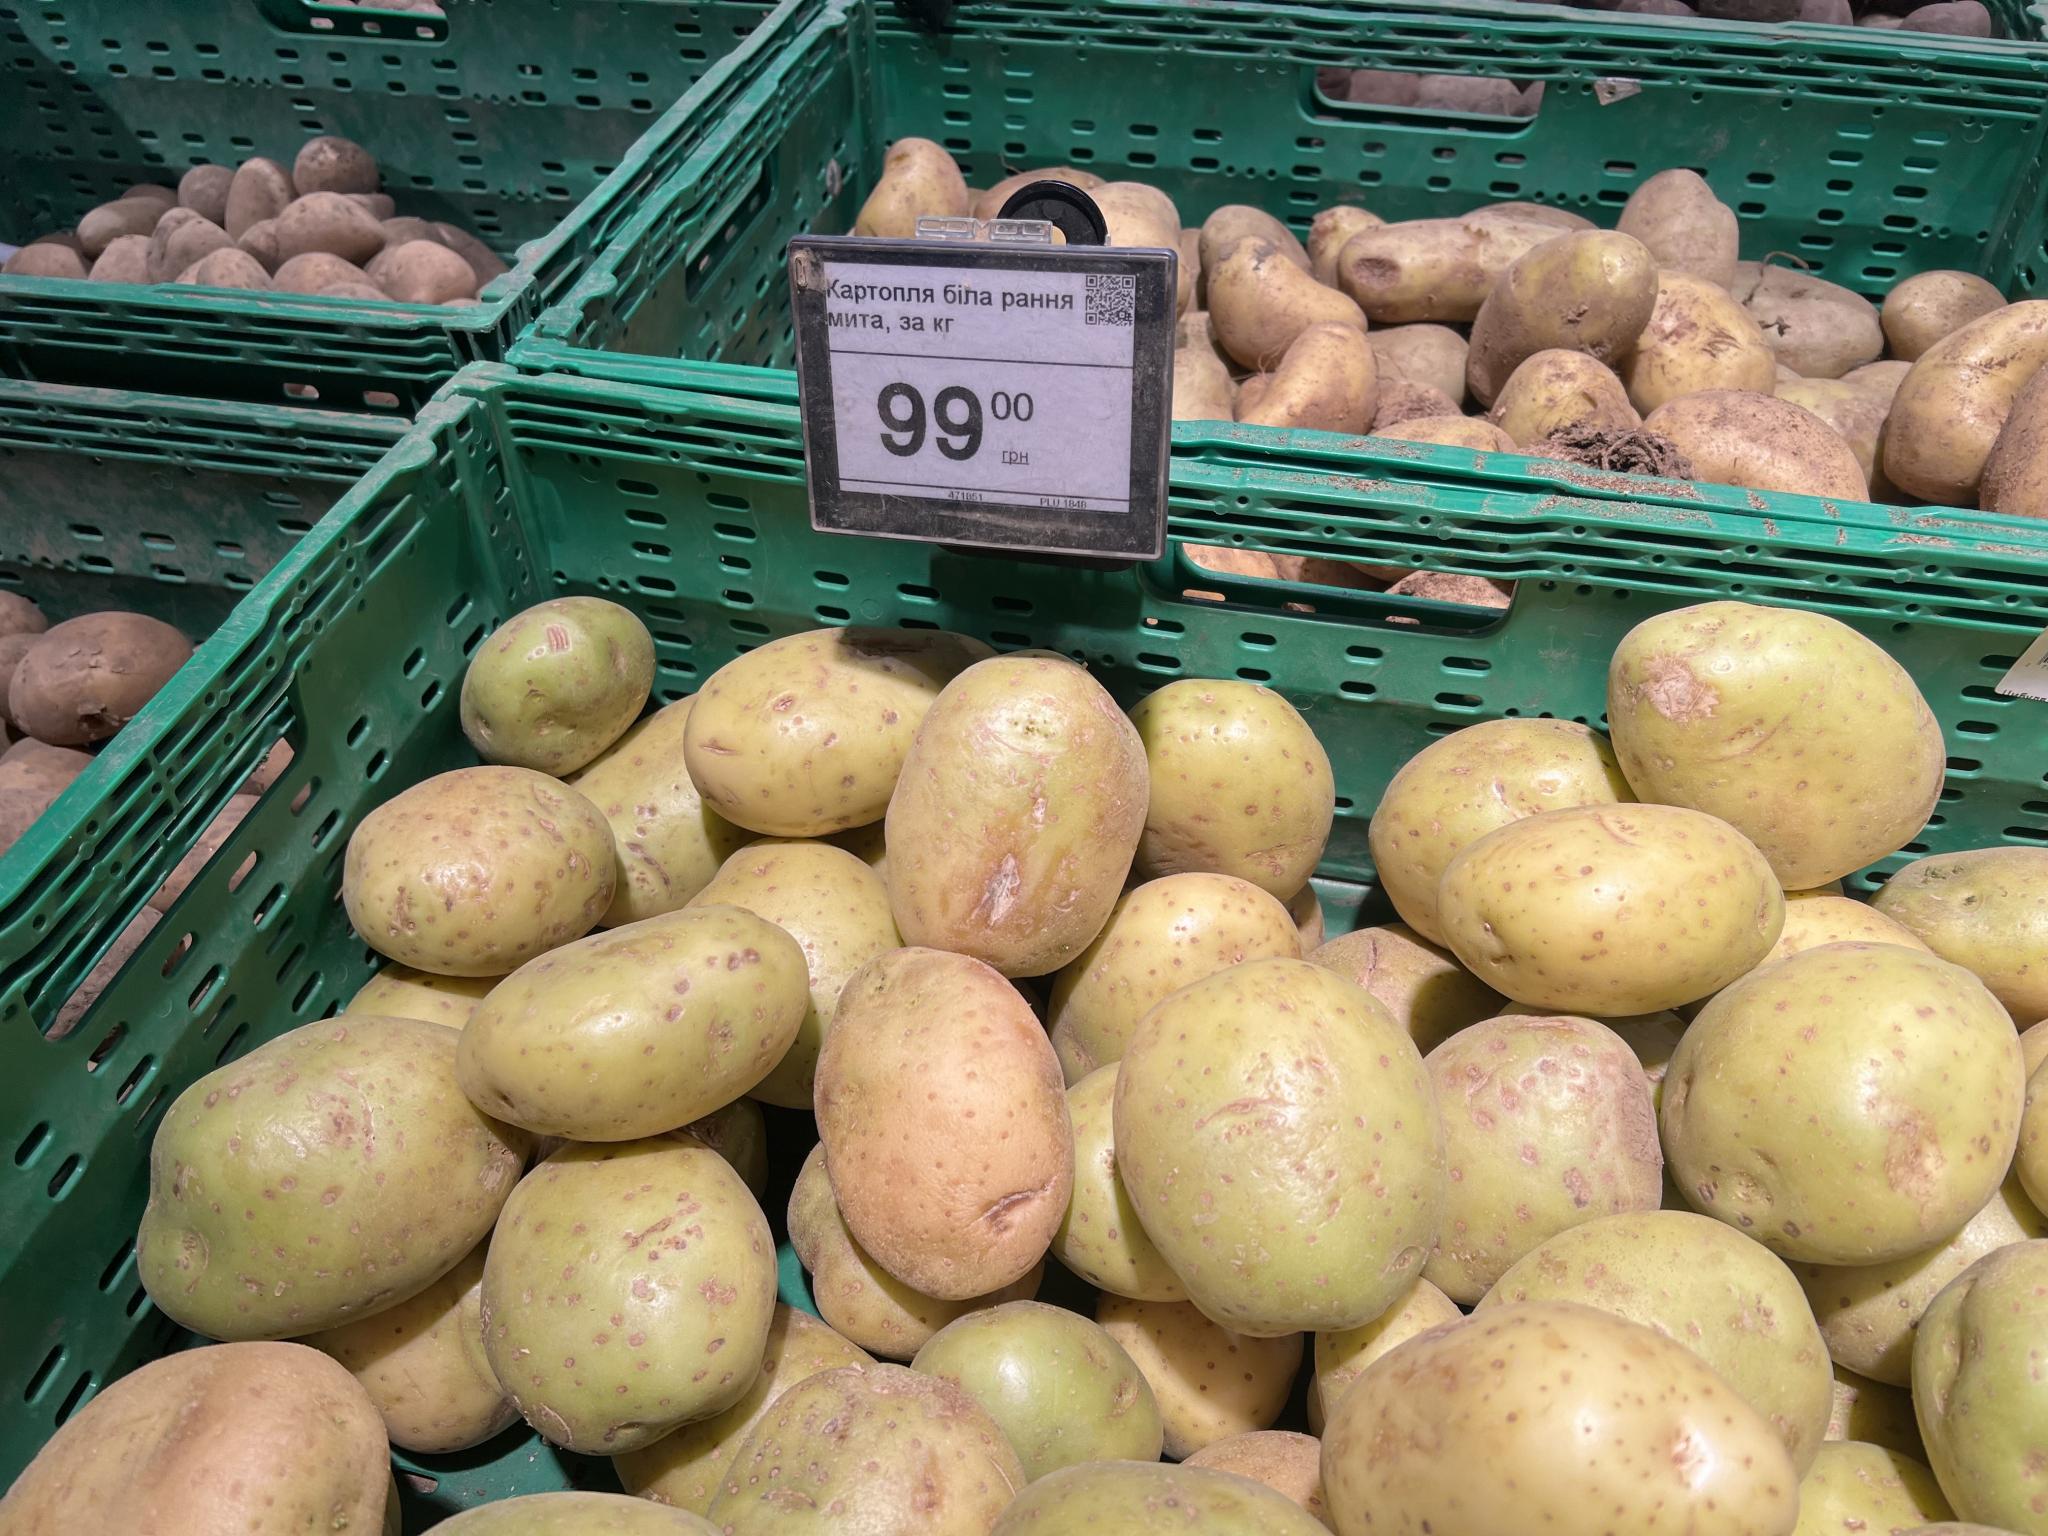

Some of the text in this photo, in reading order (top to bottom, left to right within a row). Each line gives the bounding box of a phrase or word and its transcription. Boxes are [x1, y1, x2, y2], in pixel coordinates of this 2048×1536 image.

[827, 279, 1073, 312] Картопля біла рання
[828, 312, 955, 333] мита, за кг
[877, 382, 1034, 461] 99 00
[1002, 450, 1029, 465] грн
[1040, 498, 1060, 507] PLU
